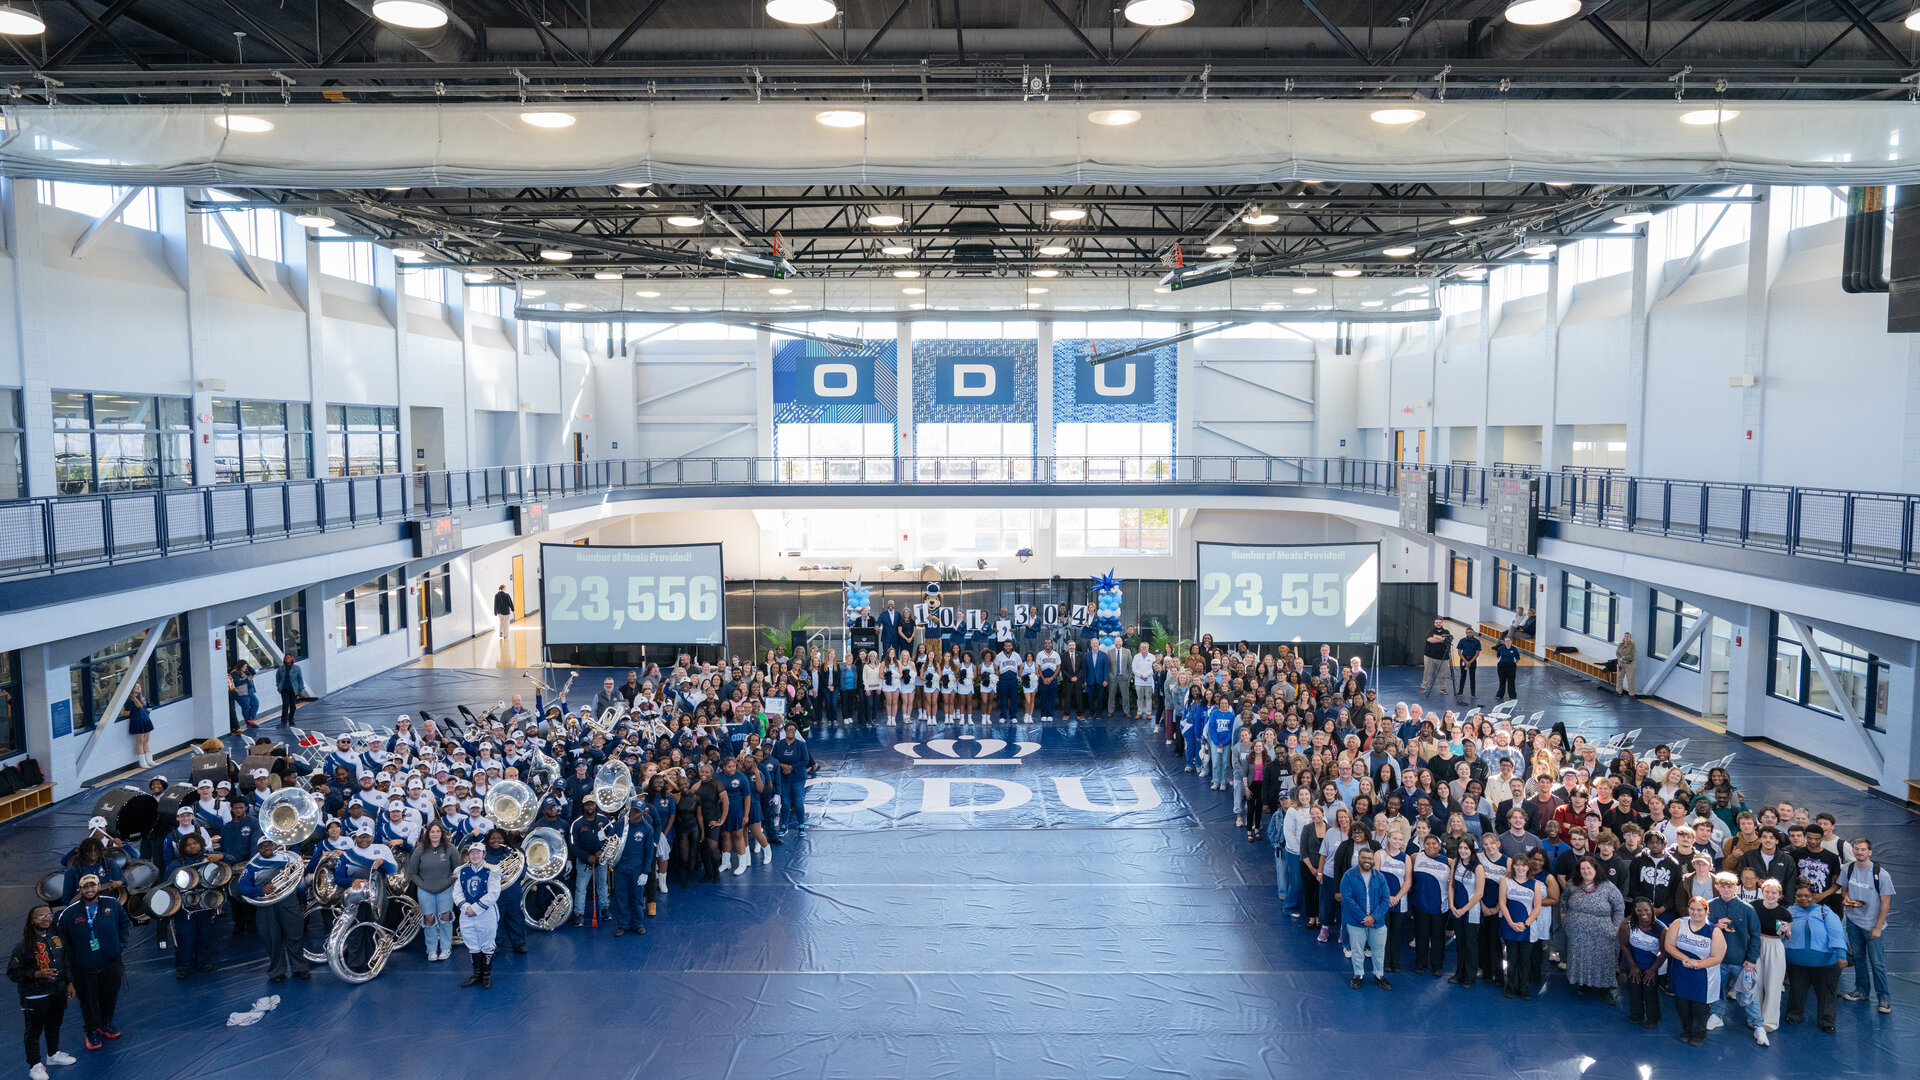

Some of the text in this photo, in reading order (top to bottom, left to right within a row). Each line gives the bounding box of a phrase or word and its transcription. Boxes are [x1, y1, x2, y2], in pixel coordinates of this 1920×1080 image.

[814, 363, 1136, 397] O D U
[576, 552, 692, 562] Number of Meals Provided!
[1231, 551, 1346, 560] Number of Meals Provided!
[549, 575, 717, 630] 23,556
[1203, 572, 1366, 625] 23,55
[941, 607, 953, 627] 0
[970, 610, 979, 630] 1
[1016, 605, 1027, 625] 3
[1044, 605, 1057, 625] 0
[1073, 606, 1086, 625] 4
[804, 776, 1162, 813] ODU
